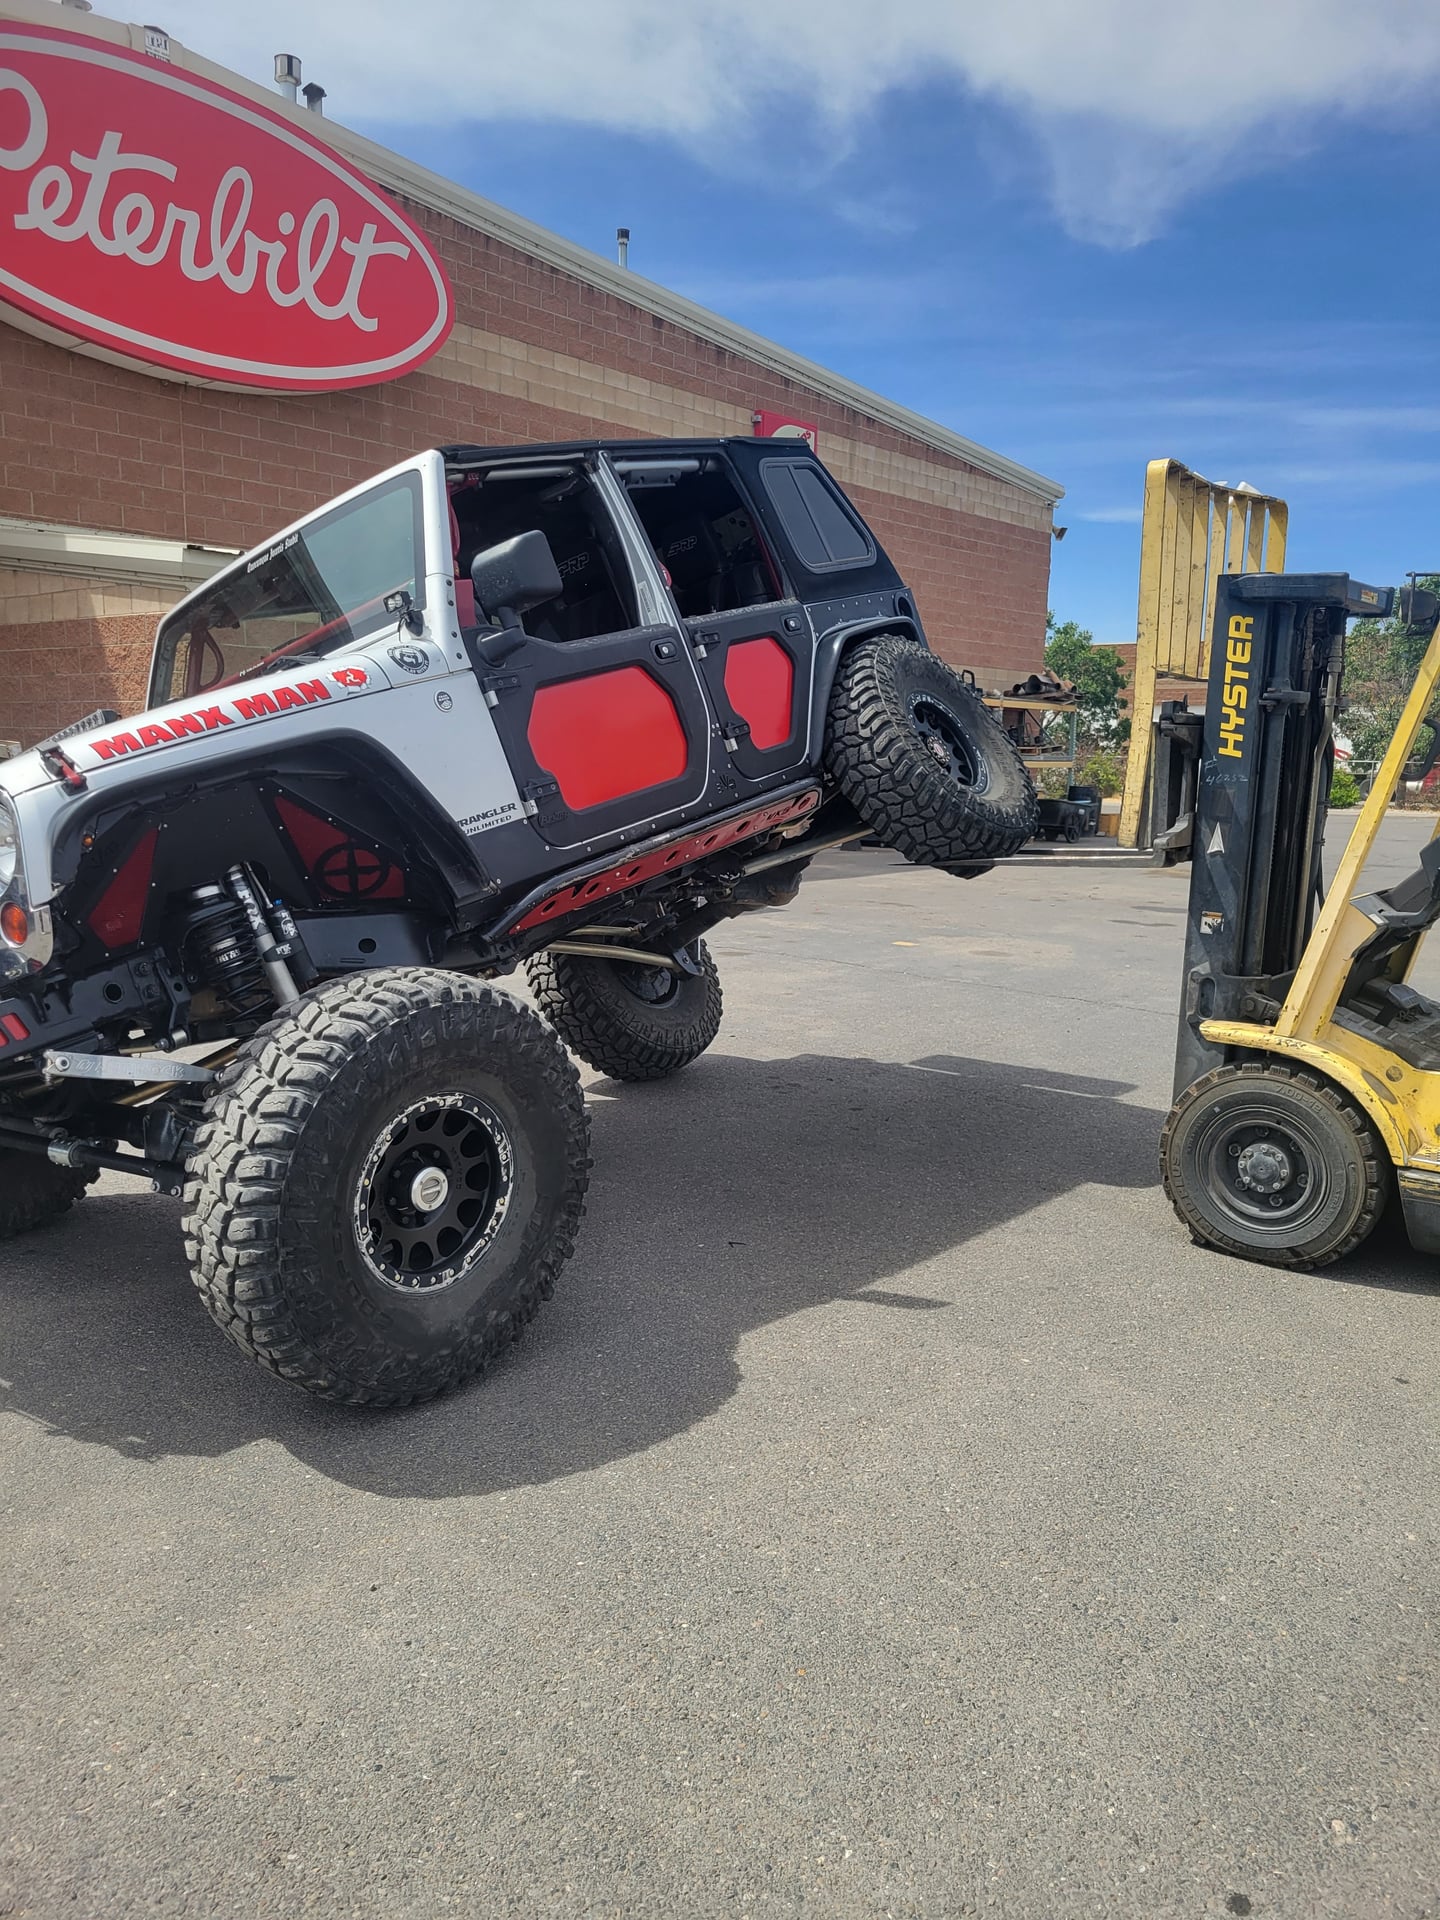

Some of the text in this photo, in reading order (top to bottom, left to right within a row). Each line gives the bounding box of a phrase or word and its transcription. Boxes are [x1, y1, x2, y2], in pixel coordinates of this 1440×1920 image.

[89, 679, 333, 761] MANX MAN
[1218, 615, 1254, 759] HYSTER
